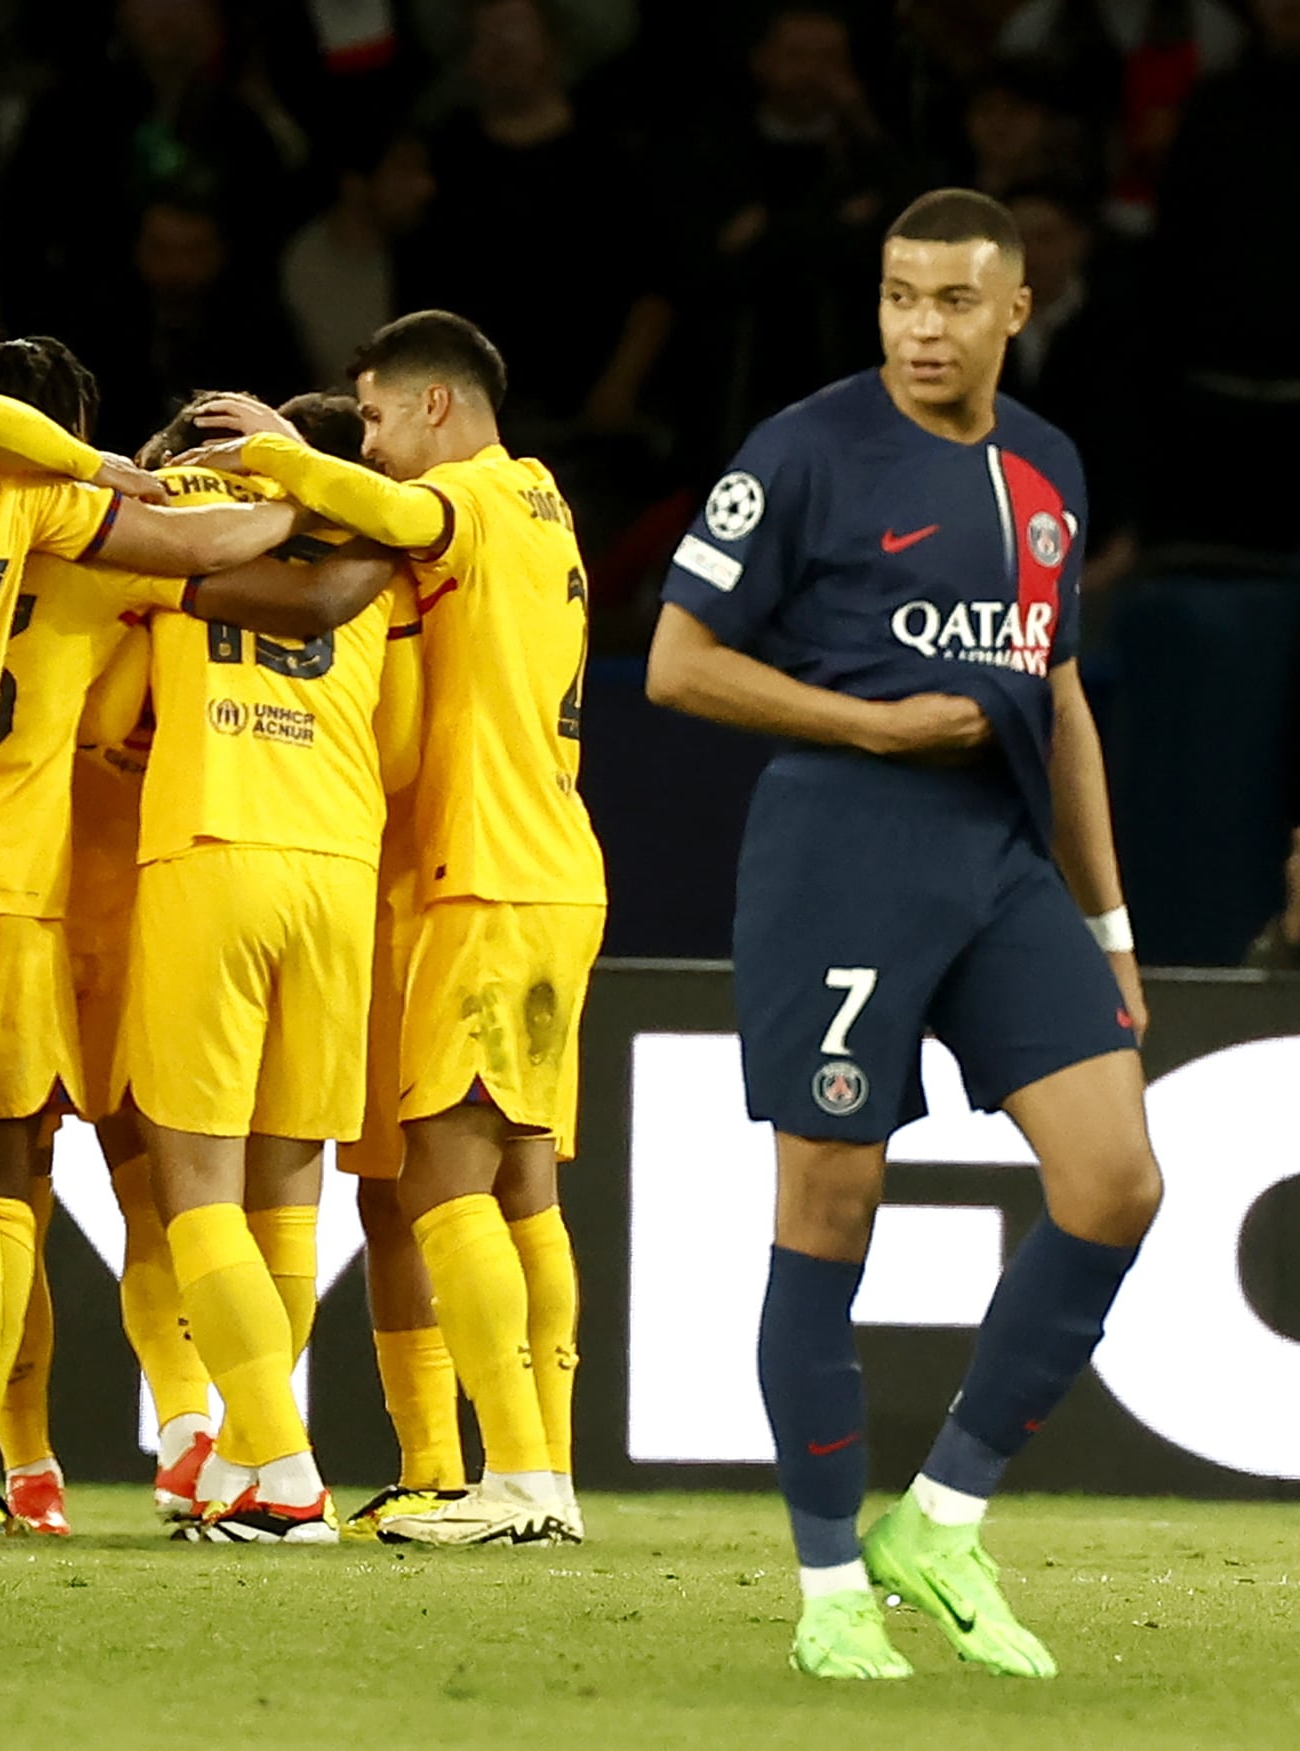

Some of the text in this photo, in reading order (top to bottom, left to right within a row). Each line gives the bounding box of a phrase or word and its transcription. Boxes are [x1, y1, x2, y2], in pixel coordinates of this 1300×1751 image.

[891, 599, 1053, 658] QATAR
[252, 719, 314, 742] ACNUR
[255, 703, 315, 725] UNHCR
[821, 967, 878, 1055] 7
